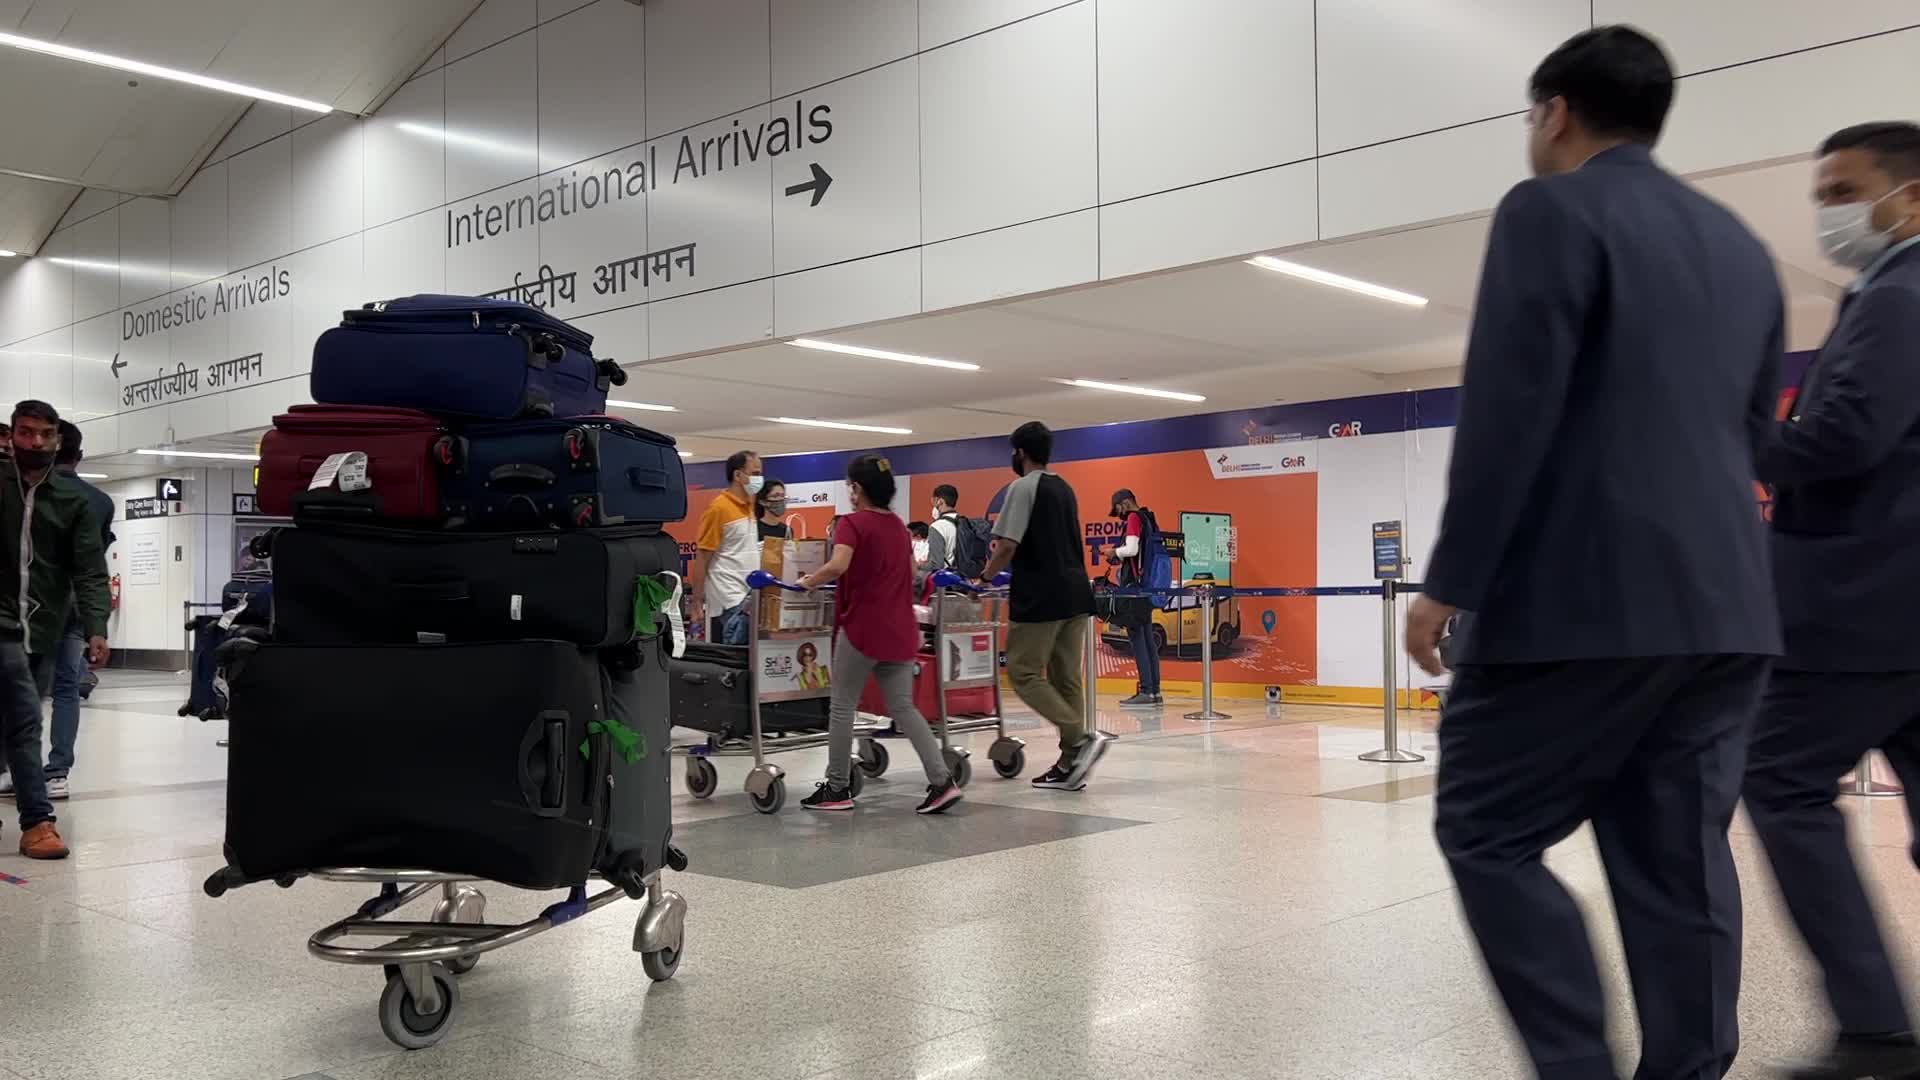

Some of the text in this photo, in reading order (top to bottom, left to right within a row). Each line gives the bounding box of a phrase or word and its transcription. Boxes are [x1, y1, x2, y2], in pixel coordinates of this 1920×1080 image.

[447, 100, 833, 248] International Arrivals
[592, 242, 697, 296] आगमन
[122, 265, 290, 341] Domestic Arrivals
[207, 352, 264, 388] आगमन
[1328, 421, 1362, 438] GMR
[1221, 463, 1240, 473] DELHI
[1281, 456, 1306, 468] GMR
[1085, 521, 1127, 536] FROM
[679, 542, 697, 553] FRO
